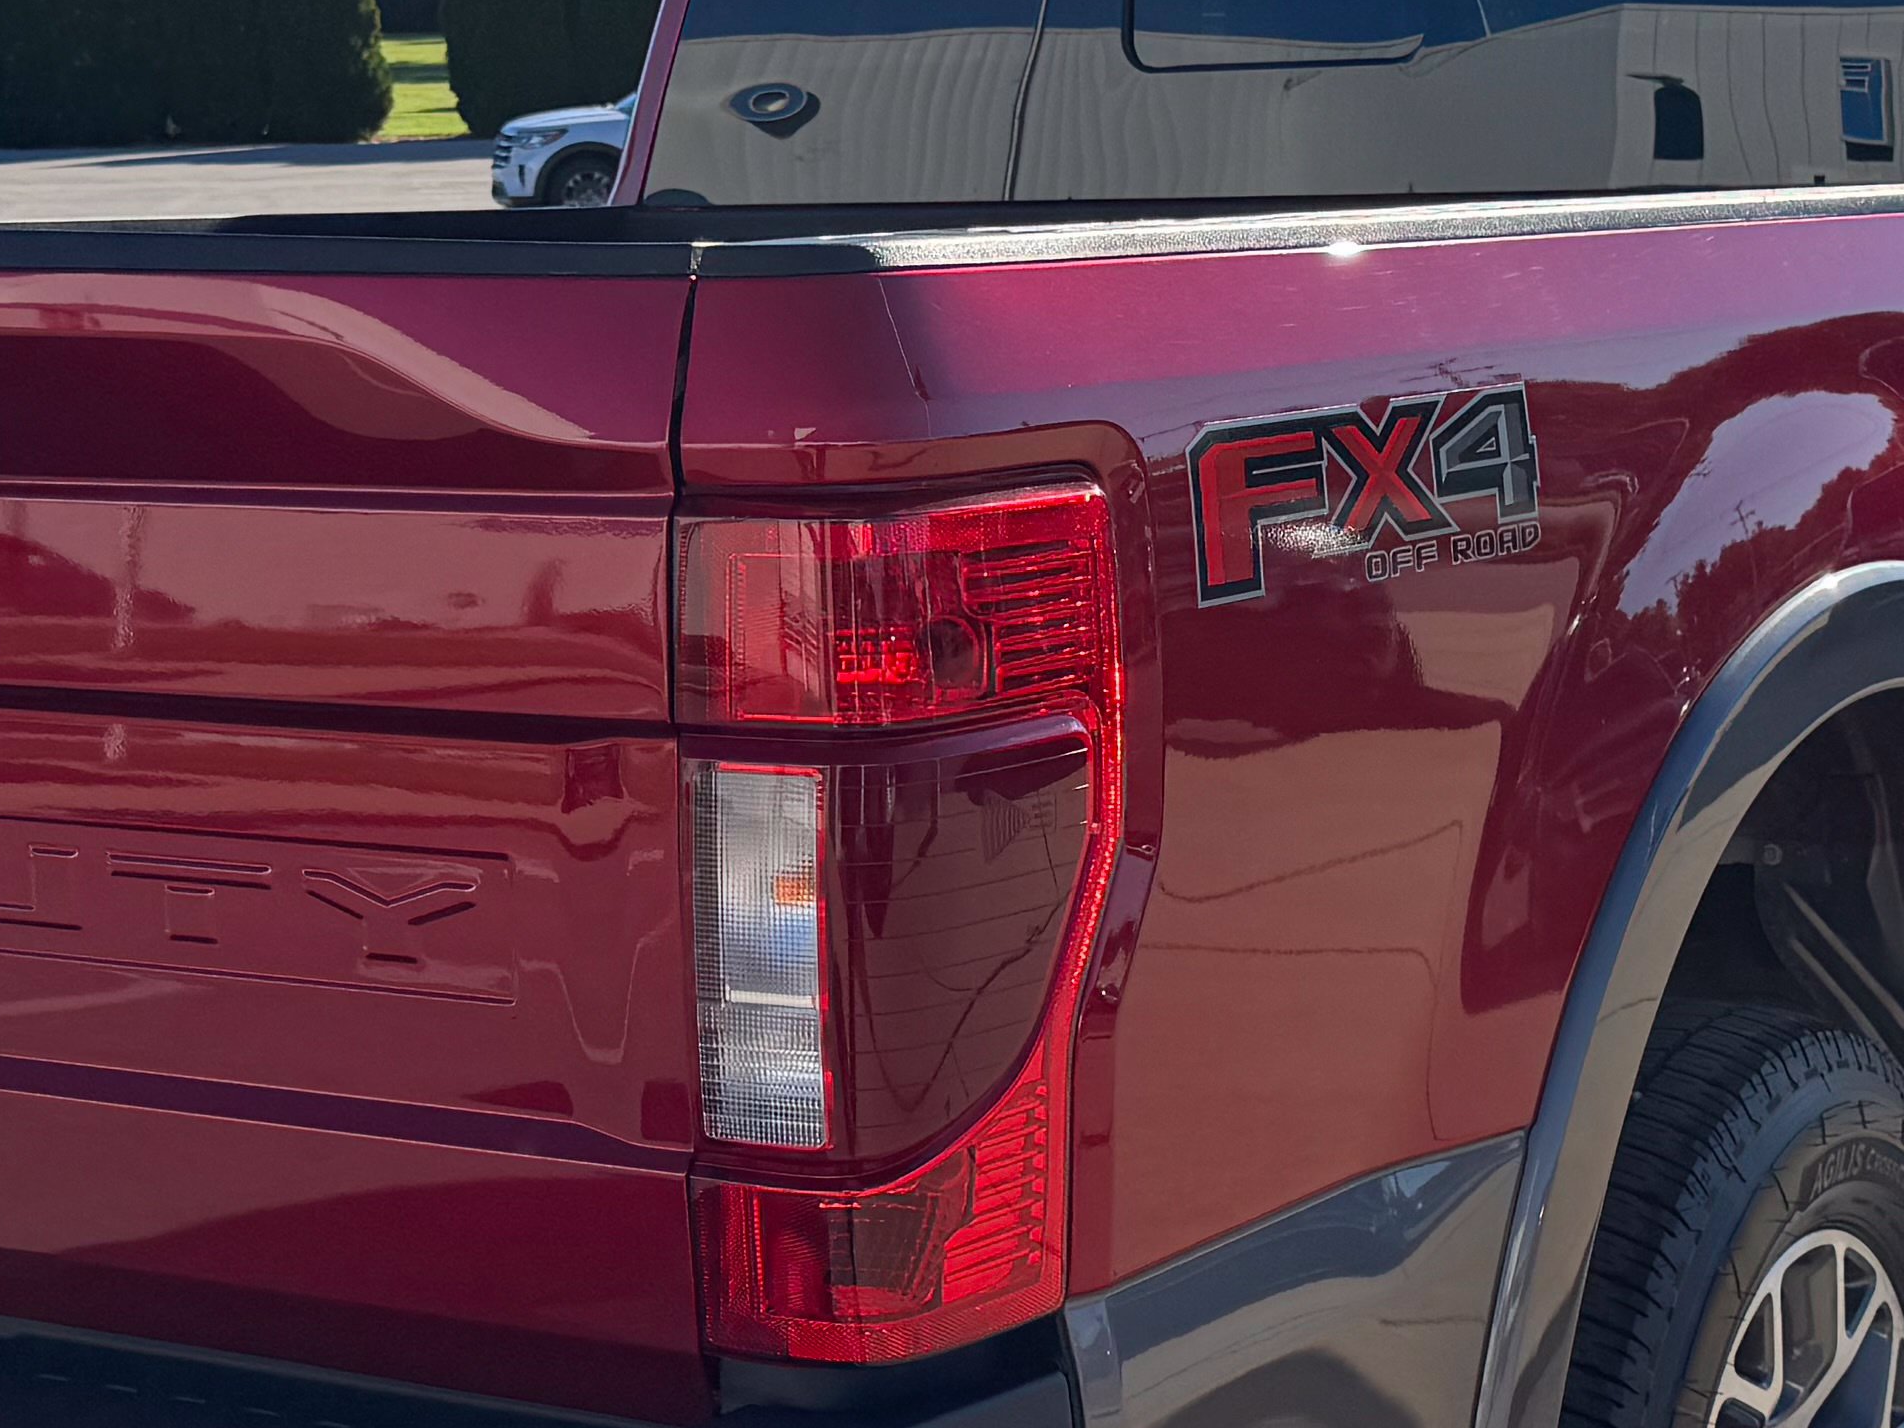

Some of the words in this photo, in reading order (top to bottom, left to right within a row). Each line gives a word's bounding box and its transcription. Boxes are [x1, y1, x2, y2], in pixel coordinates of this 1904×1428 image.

[1185, 381, 1540, 608] FX4
[1365, 542, 1438, 582] OFF
[1450, 523, 1540, 565] ROAD
[1807, 1142, 1867, 1200] AGILIS
